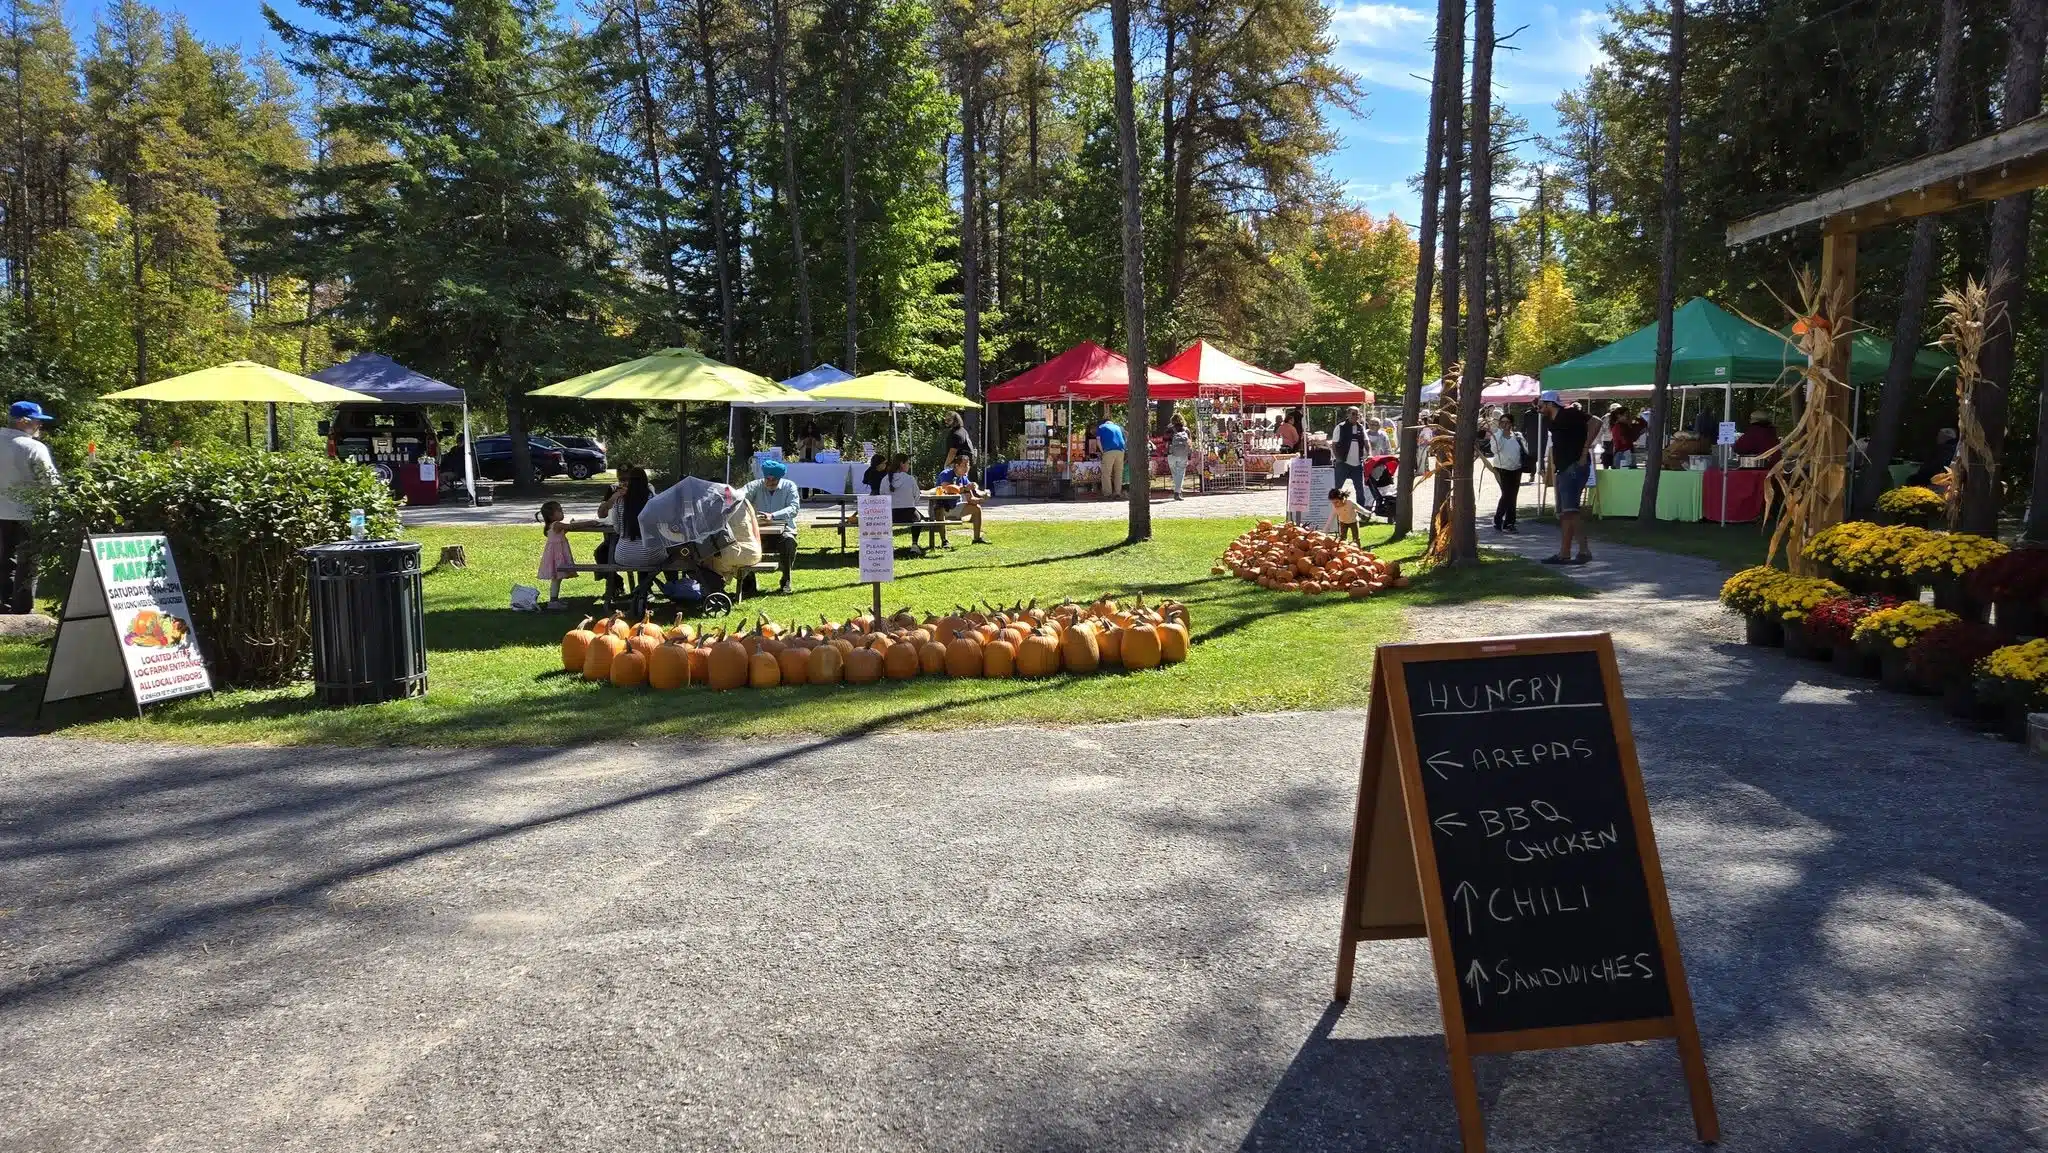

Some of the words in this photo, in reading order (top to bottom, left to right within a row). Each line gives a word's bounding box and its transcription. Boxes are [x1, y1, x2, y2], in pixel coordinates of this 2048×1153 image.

[112, 559, 168, 582] MARKET
[113, 602, 124, 611] MAY
[123, 600, 138, 610] LONG
[134, 667, 150, 678] LOG
[149, 665, 169, 676] FARM
[168, 659, 202, 672] ENTRANCE
[141, 652, 172, 665] LOCATED
[172, 651, 179, 660] AT
[139, 681, 152, 691] ALL
[151, 677, 174, 688] LOCAL
[172, 671, 203, 684] VENDORS
[1428, 673, 1562, 711] HUNGRY
[1472, 738, 1594, 770] AREPAS
[1478, 799, 1574, 838] BBQ
[1505, 822, 1619, 862] CHICKEN
[1488, 885, 1591, 923] CHILI
[1495, 951, 1654, 996] SANDWICHES
